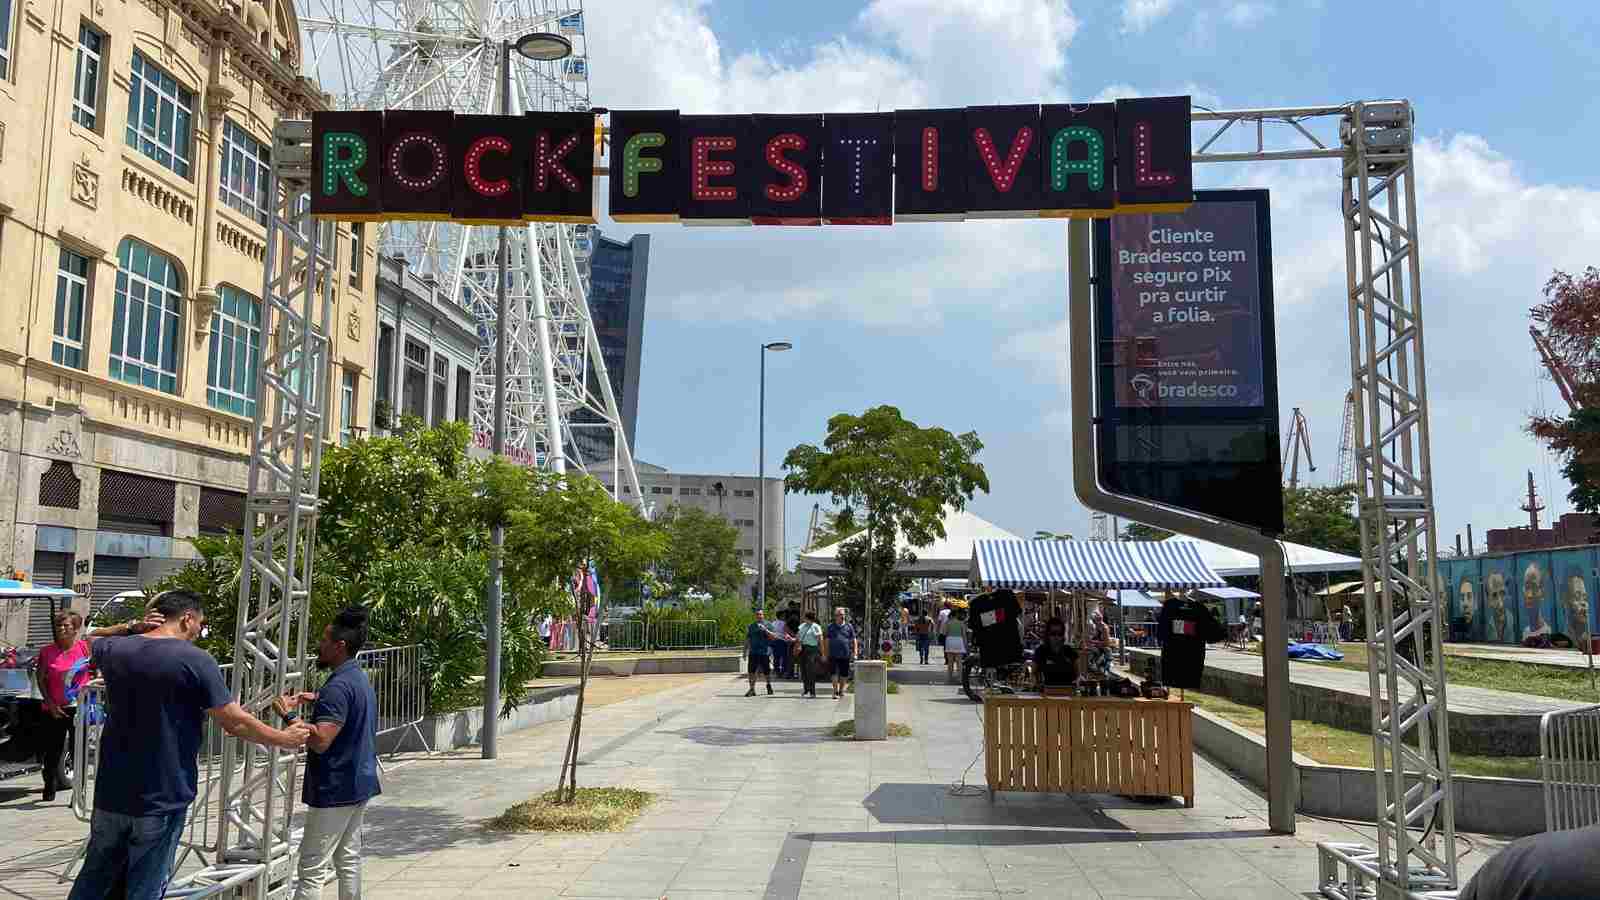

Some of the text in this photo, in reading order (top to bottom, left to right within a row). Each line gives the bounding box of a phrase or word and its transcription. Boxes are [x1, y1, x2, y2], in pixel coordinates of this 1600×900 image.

[322, 122, 1176, 201] ROCK FESTIVAL
[1149, 229, 1214, 243] Cliente
[1119, 249, 1246, 264] Bradesco tem
[1133, 267, 1232, 287] seguro Pix
[1139, 287, 1227, 307] pra curtir
[1152, 307, 1216, 323] a folia.
[1158, 379, 1238, 398] bradesco
